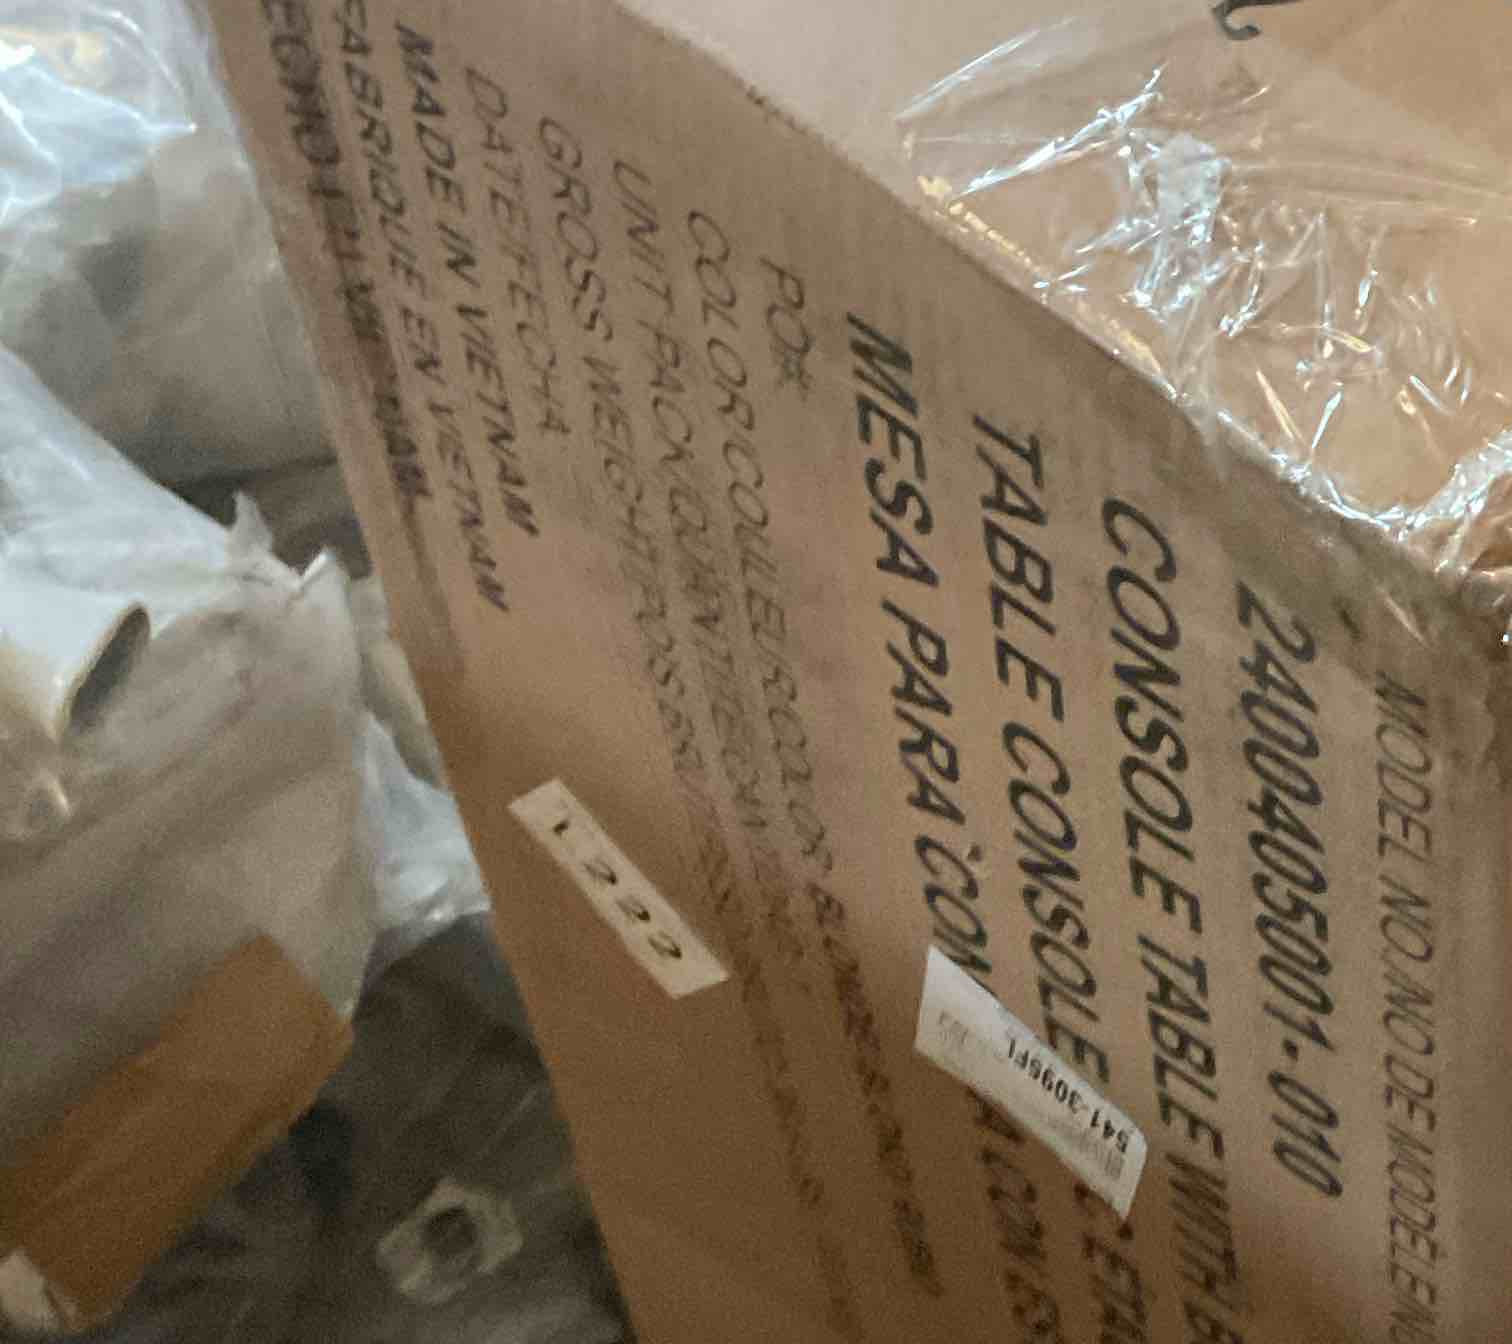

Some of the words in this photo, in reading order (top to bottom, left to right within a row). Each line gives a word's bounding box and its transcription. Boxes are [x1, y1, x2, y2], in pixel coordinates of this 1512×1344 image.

[391, 15, 466, 215] MADE
[535, 113, 614, 336] GROSS
[434, 215, 480, 291] IN
[606, 148, 679, 324] UNIT
[397, 298, 449, 392] EN
[425, 401, 512, 622] VIETNAM
[454, 304, 543, 545] VIETNAM
[842, 306, 943, 602] MESA
[969, 406, 1067, 727] TABLE
[879, 595, 968, 836] PARA
[1096, 481, 1203, 940] CONSOLE
[1372, 665, 1431, 887] MODEL
[995, 707, 1110, 1087] CONSOLE
[1134, 919, 1226, 1168] TABLE
[1379, 1044, 1434, 1146] DE
[1162, 1148, 1239, 1321] WITH
